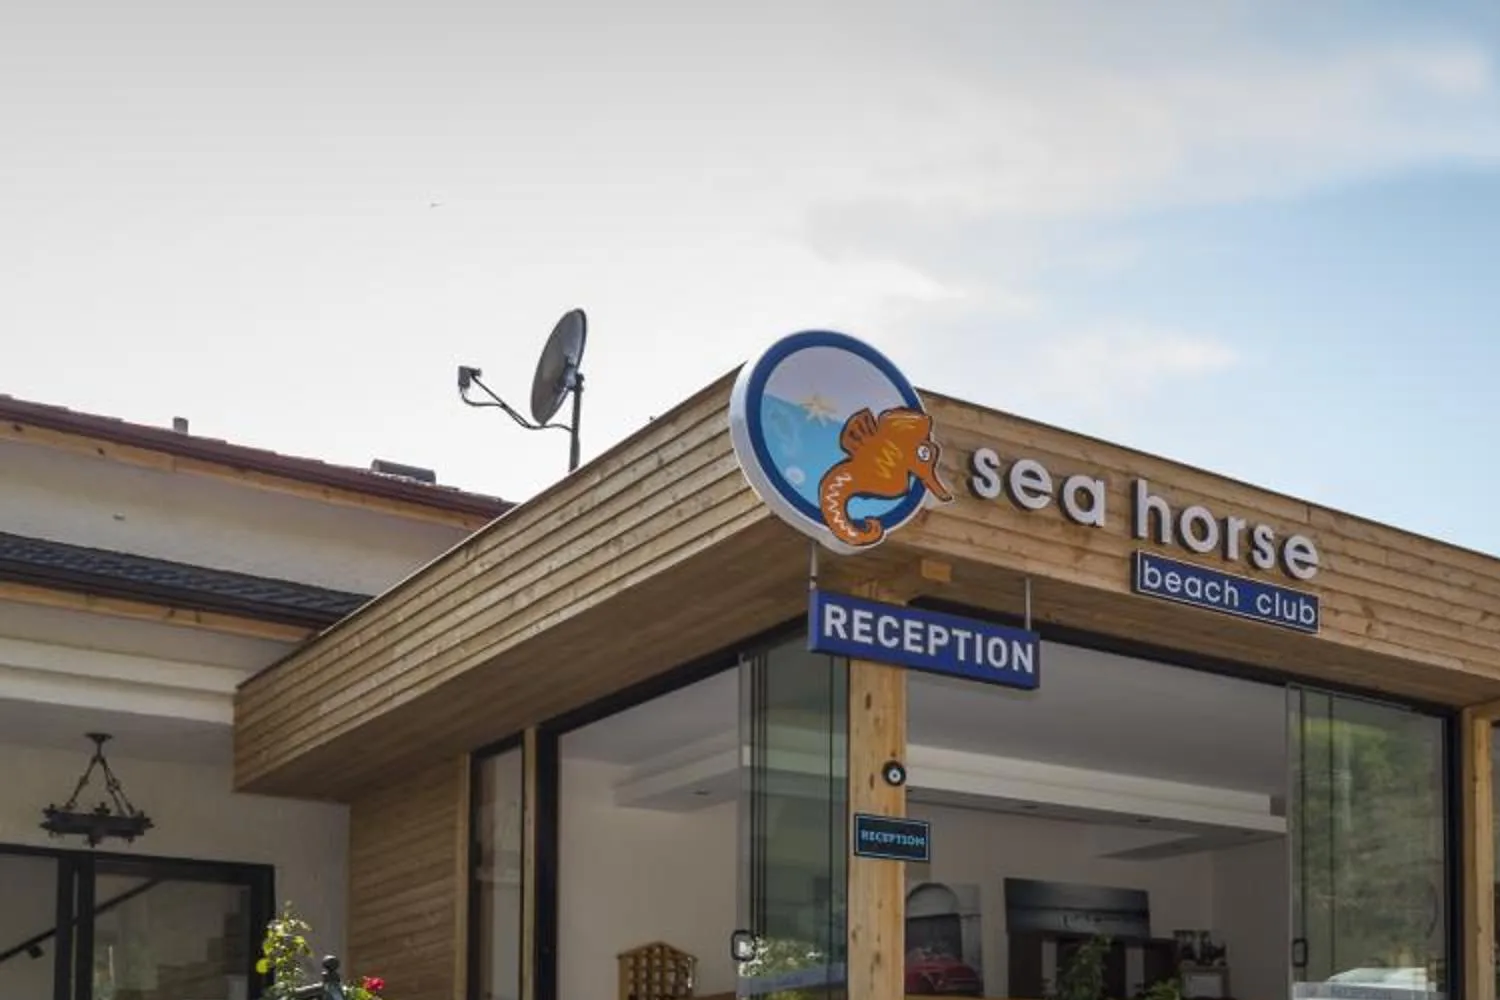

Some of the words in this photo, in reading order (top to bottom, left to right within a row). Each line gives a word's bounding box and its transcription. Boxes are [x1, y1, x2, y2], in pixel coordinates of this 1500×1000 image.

[972, 447, 1105, 528] sea
[1134, 478, 1320, 580] horse
[1142, 558, 1240, 607] beach
[1255, 592, 1316, 625] club
[823, 603, 1034, 674] RECEPTION
[860, 829, 926, 846] RECEPTION
